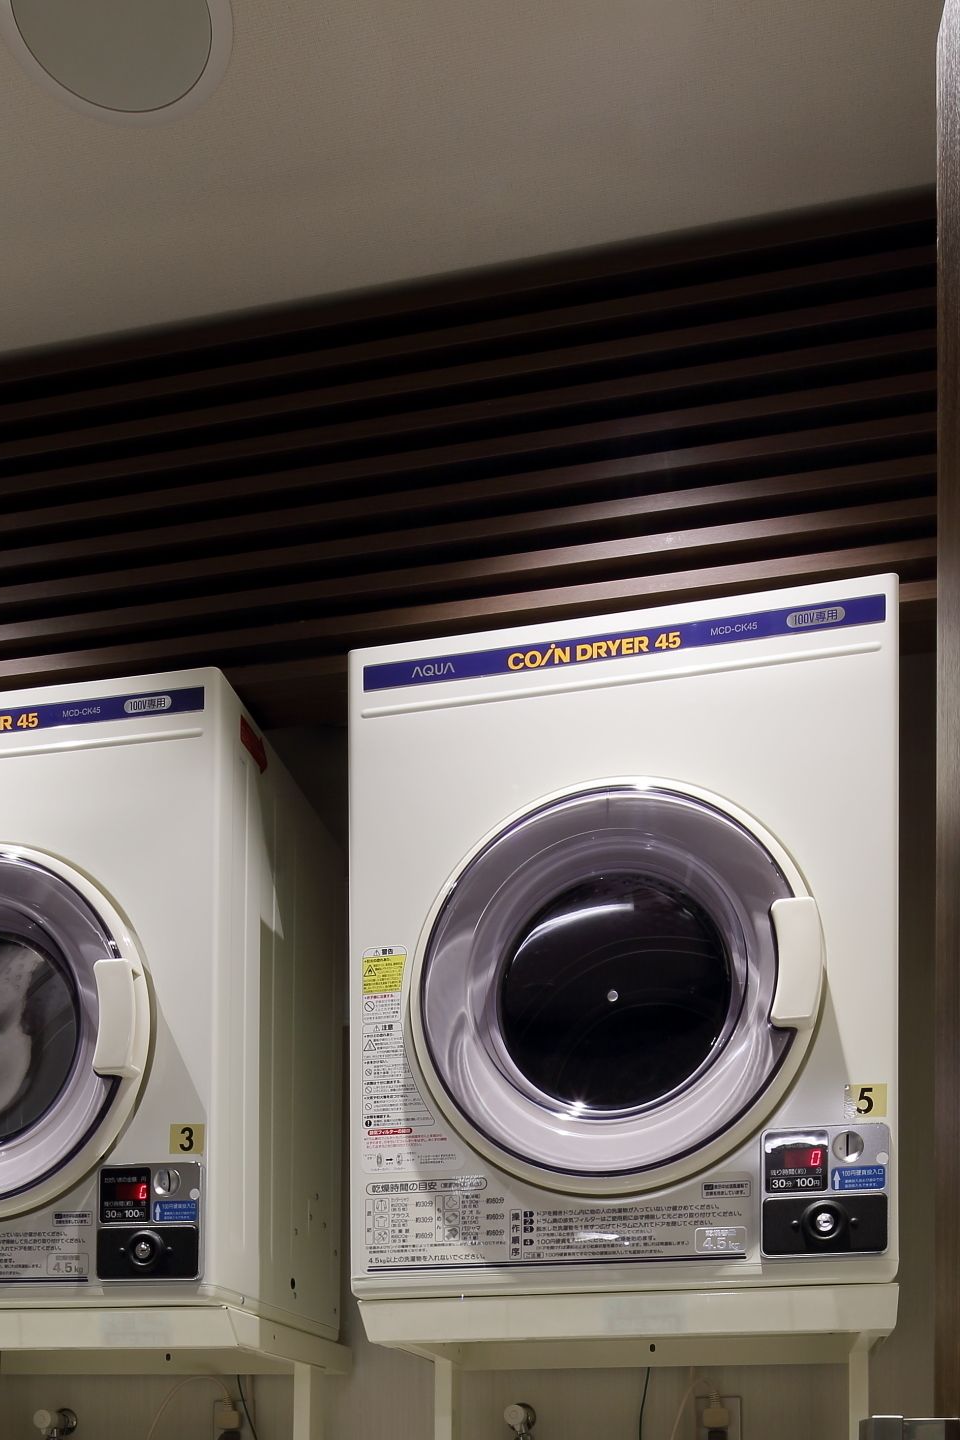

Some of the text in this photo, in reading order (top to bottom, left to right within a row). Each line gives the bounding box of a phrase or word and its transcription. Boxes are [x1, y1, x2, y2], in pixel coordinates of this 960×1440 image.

[411, 609, 839, 677] AQUA COIN DRYER 45 MCD-CK45 100V専用
[17, 712, 38, 729] 45
[62, 706, 101, 718] MCD-CK45
[129, 697, 167, 710] 100V専用
[856, 1087, 874, 1114] 5
[179, 1127, 194, 1152] 3
[810, 1150, 821, 1166] 0
[371, 1182, 437, 1193] 乾燥時間の目安
[772, 1177, 820, 1189] 30分 100円
[124, 1209, 145, 1218] 100円
[53, 1262, 72, 1273] 4.5
